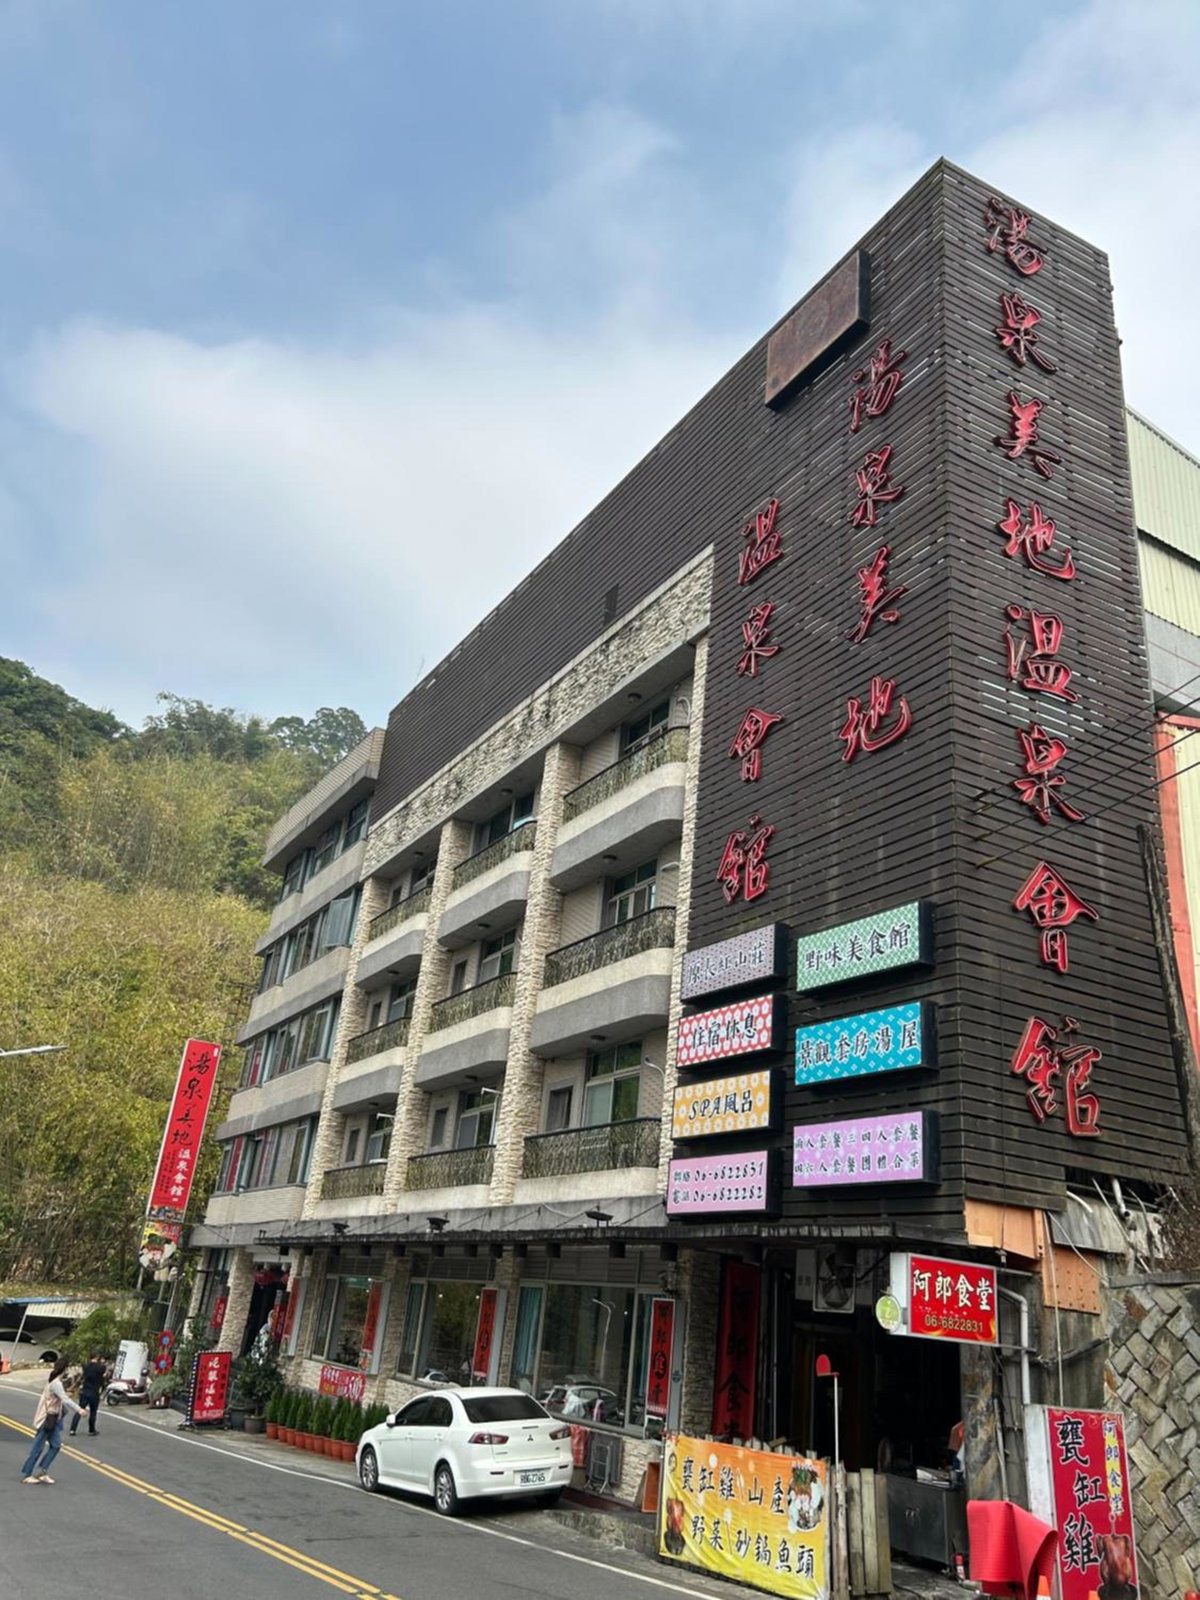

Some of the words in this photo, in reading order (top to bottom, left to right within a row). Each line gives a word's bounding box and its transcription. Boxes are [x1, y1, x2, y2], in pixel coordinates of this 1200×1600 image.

[838, 338, 912, 763] 湯泉美地
[983, 196, 1103, 1137] 湯泉美地溫泉會館
[716, 497, 784, 904] 溫泉會館
[805, 922, 911, 971] 野味美食館
[692, 1013, 758, 1049] 住宿休息
[800, 1020, 918, 1069] 景觀套房湯屋
[688, 1089, 753, 1121] SPA風呂
[913, 1268, 993, 1311] 阿郎食堂
[924, 1313, 984, 1333] 06-6822831
[681, 1456, 736, 1501] 甕缸雞
[747, 1475, 786, 1515] 山產
[1055, 1415, 1106, 1573] 甕缸雞
[1102, 1420, 1124, 1513] 阿郎食堂
[690, 1515, 724, 1552] 野菜
[735, 1527, 815, 1579] 砂鍋魚頭
